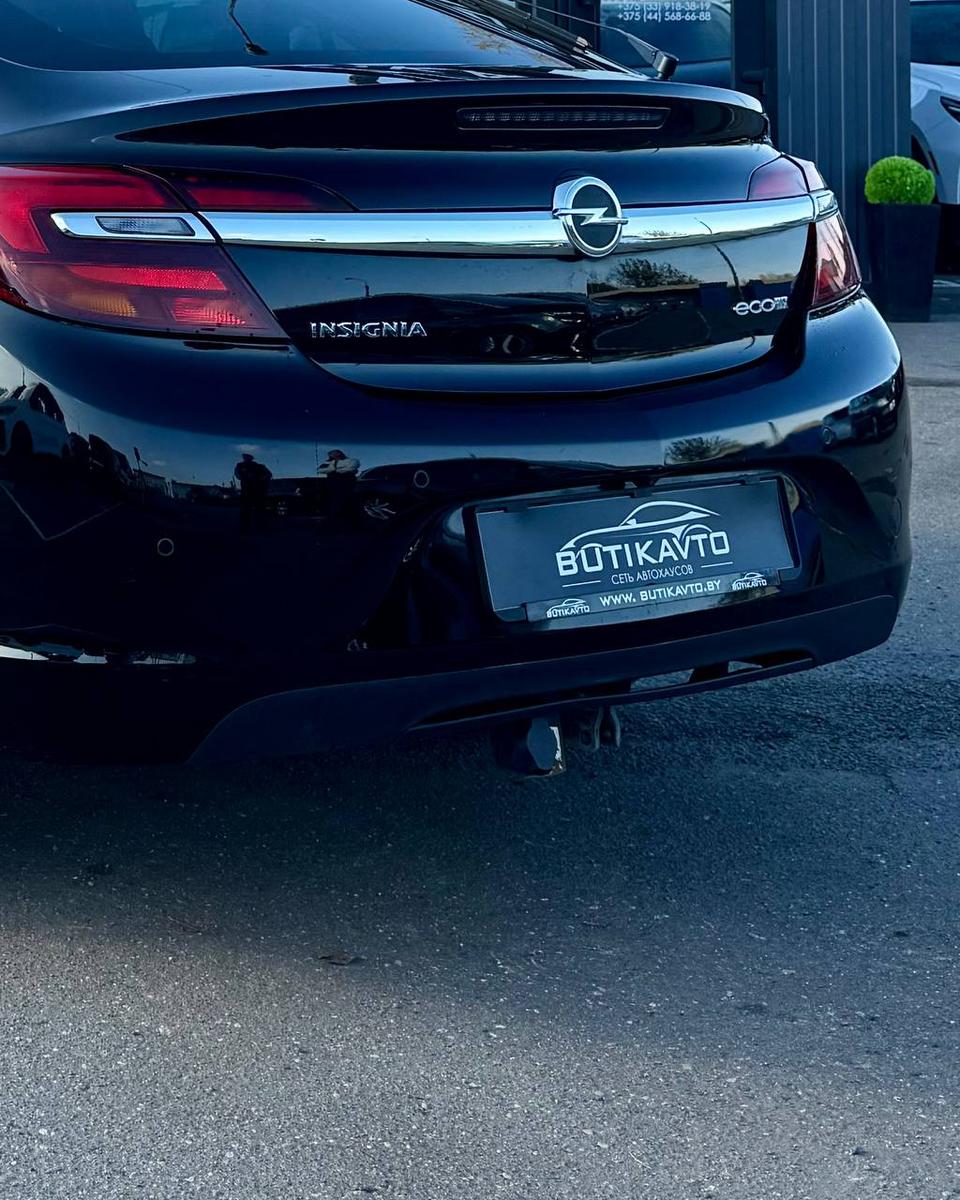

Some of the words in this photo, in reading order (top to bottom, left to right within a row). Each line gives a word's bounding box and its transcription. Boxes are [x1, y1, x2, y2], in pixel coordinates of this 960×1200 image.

[617, 2, 641, 11] +375
[643, 2, 661, 12] (33)
[664, 2, 711, 11] 918-38-19
[617, 12, 641, 21] +375
[643, 12, 661, 23] (44)
[664, 12, 711, 21] 568-66-88
[310, 321, 428, 338] INSIGNIA
[555, 530, 730, 577] BUTIKAVTO
[611, 571, 635, 585] СЕТЬ
[636, 564, 694, 582] АВТОХАУСОВ
[599, 593, 636, 607] WWW.
[640, 579, 721, 602] BUTIKAVTO.BY
[546, 605, 590, 618] BUTIKAVTO
